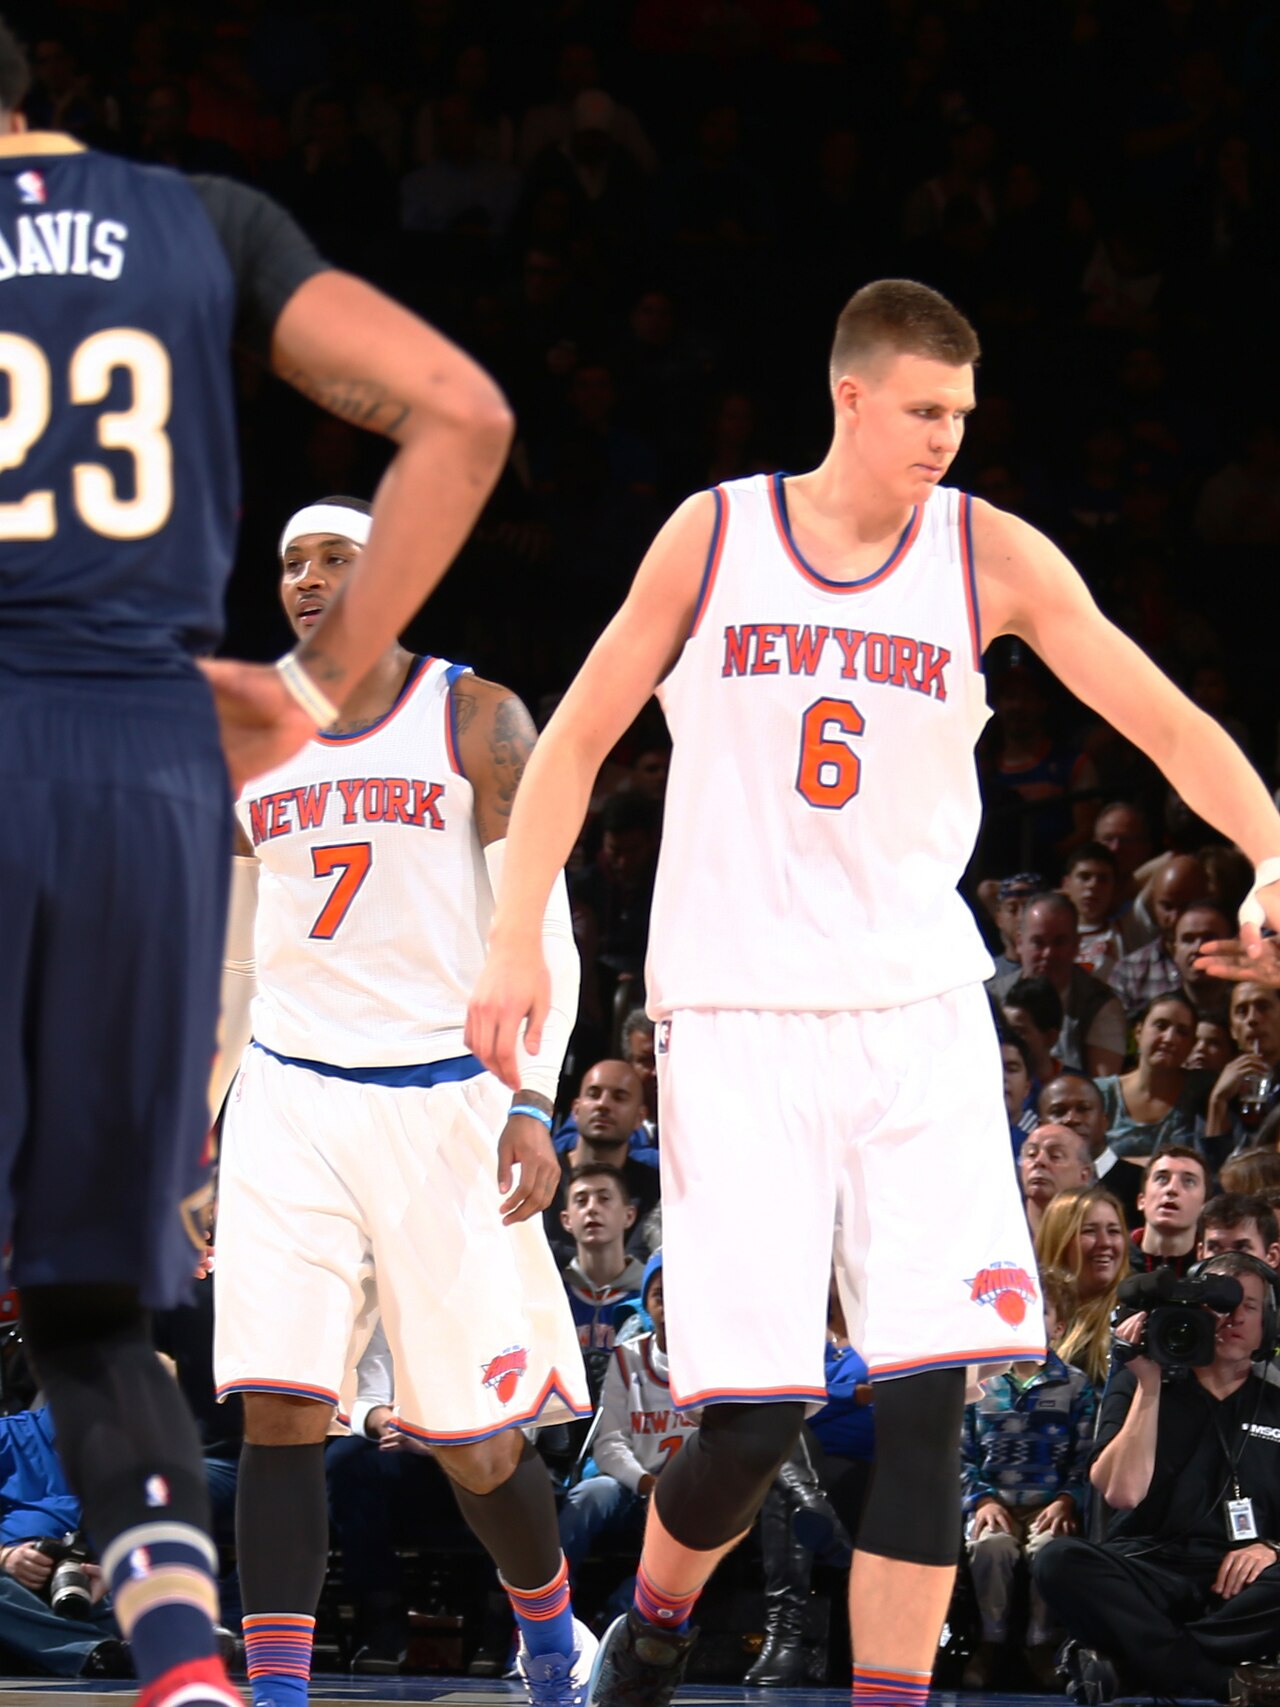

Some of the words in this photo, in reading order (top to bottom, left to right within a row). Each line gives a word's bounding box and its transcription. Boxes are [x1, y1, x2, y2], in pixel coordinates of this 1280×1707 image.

[0, 328, 174, 540] 23
[722, 624, 830, 678] NEW
[832, 628, 951, 701] YORK
[795, 696, 865, 810] 6
[249, 783, 331, 843] NEW
[336, 778, 446, 831] YORK
[308, 841, 372, 940] 7
